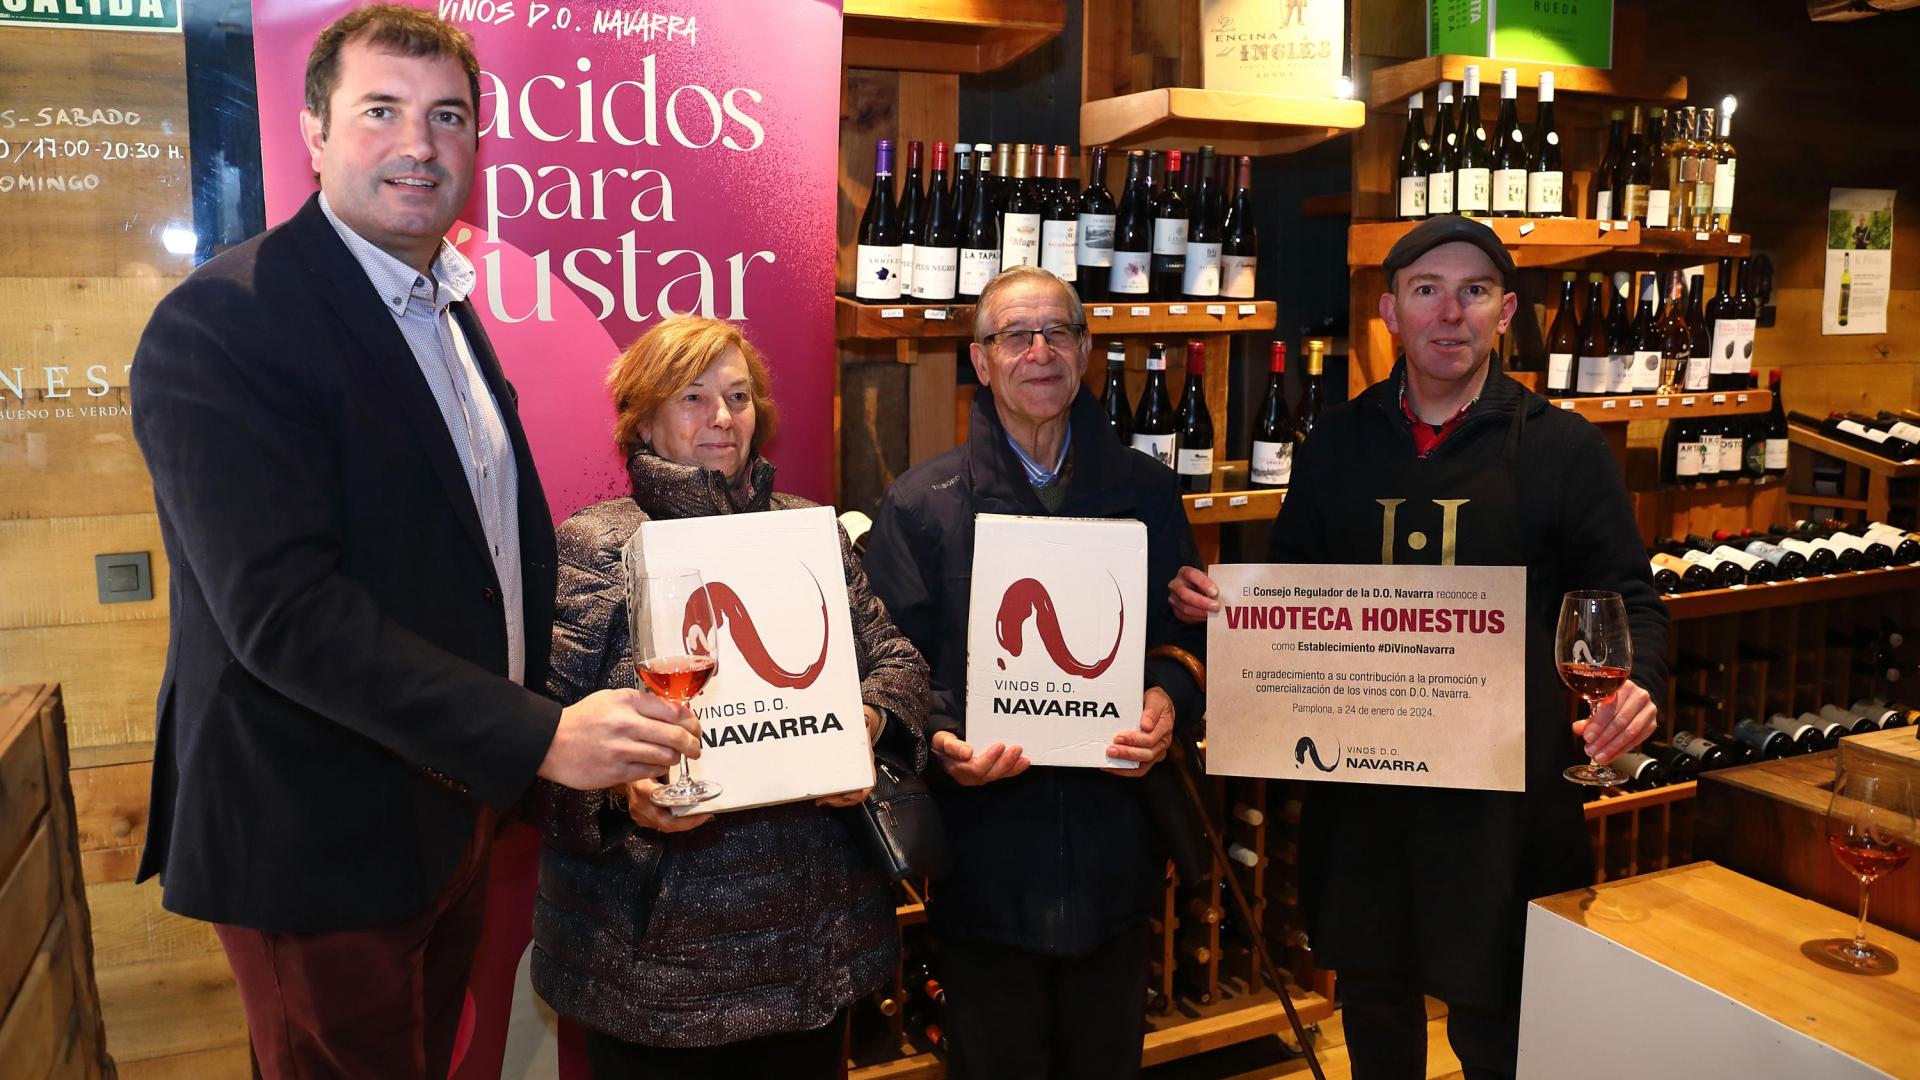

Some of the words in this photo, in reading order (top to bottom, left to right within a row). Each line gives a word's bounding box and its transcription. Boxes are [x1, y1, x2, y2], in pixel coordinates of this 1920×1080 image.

[1534, 0, 1577, 16] RUEDA
[439, 0, 515, 25] VINOS
[593, 9, 699, 46] NAVARRA
[1215, 33, 1278, 42] ENCINA
[482, 163, 676, 244] para
[965, 250, 975, 259] LA
[455, 229, 776, 323] ustar
[55, 408, 74, 417] DE
[1243, 586, 1251, 597] El
[1254, 586, 1292, 599] Consejo
[1295, 586, 1344, 599] Regulador
[1346, 587, 1359, 598] de
[1361, 587, 1370, 598] la
[1373, 587, 1393, 599] D.O.
[1395, 588, 1434, 599] Navarra
[1437, 590, 1479, 600] reconoce
[1481, 591, 1487, 600] a
[1225, 605, 1354, 631] VINOTECA
[1362, 607, 1506, 635] HONESTUS
[1272, 642, 1296, 651] como
[1298, 641, 1376, 653] Establecimiento
[1378, 643, 1455, 655] #DiVinoNavarra
[1243, 668, 1254, 679] En
[1256, 669, 1326, 681] agradecimiento
[1328, 672, 1334, 681] a
[1336, 672, 1347, 681] su
[1350, 671, 1406, 683] contribución
[1409, 674, 1415, 683] a
[1418, 672, 1426, 684] la
[1429, 674, 1478, 686] promoción
[1481, 676, 1487, 687] y
[995, 680, 1039, 692] VINOS
[1046, 682, 1075, 694] D.O.
[1256, 683, 1331, 695] comercialización
[1334, 684, 1345, 695] de
[1348, 685, 1361, 696] los
[1363, 686, 1388, 697] vinos
[1390, 688, 1407, 697] con
[1410, 686, 1429, 698] D.O.
[1432, 687, 1471, 699] Navarra.
[694, 702, 747, 720] VINOS
[755, 698, 788, 713] D.O.
[993, 698, 1120, 718] NAVARRA
[1293, 702, 1335, 715] Pamplona,
[1337, 706, 1343, 715] a
[1345, 704, 1356, 715] 24
[1359, 705, 1369, 715] de
[1371, 707, 1395, 716] enero
[1397, 706, 1408, 717] de
[1410, 707, 1435, 718] 2024.
[700, 712, 844, 749] NAVARRA
[1347, 746, 1376, 755] VINOS
[1380, 747, 1400, 757] D.O.
[1347, 757, 1430, 773] NAVARRA
